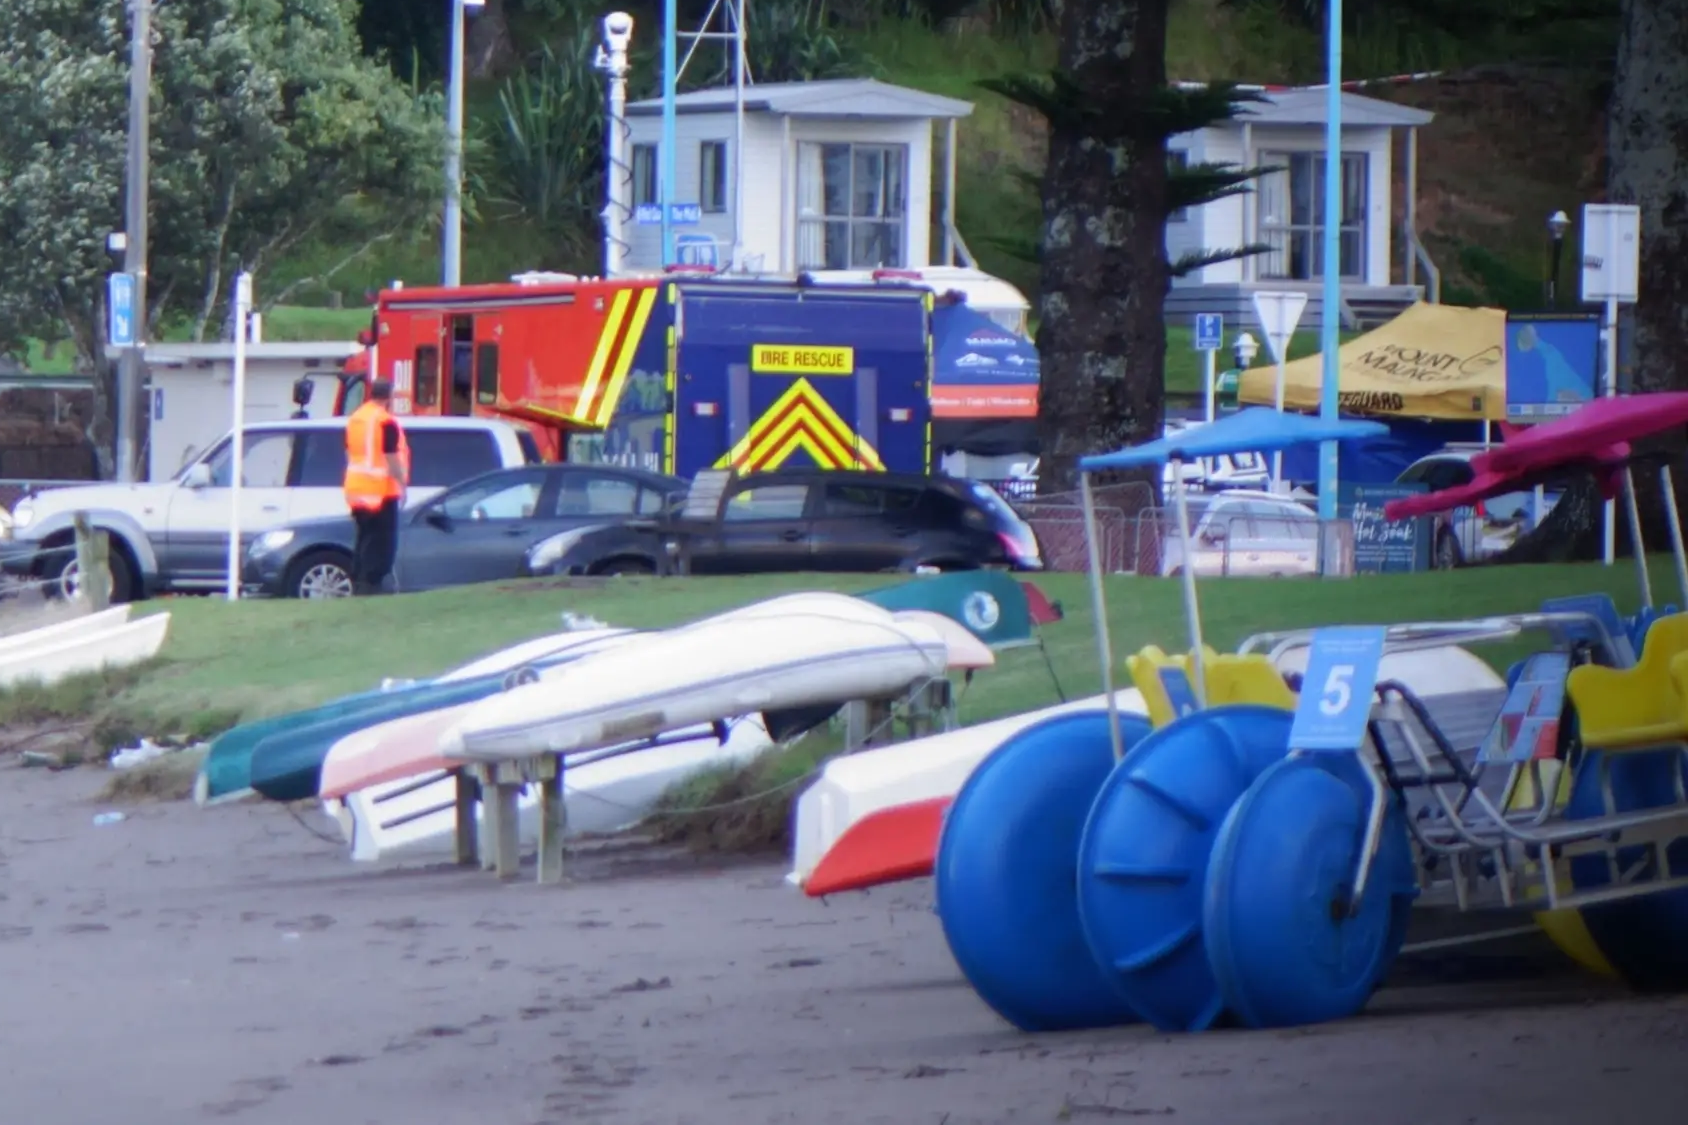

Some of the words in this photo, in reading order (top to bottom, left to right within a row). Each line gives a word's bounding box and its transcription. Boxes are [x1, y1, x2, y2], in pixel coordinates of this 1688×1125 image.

[794, 352, 845, 368] RESCUE
[1379, 344, 1460, 371] MOUNT
[1319, 665, 1354, 715] 5
